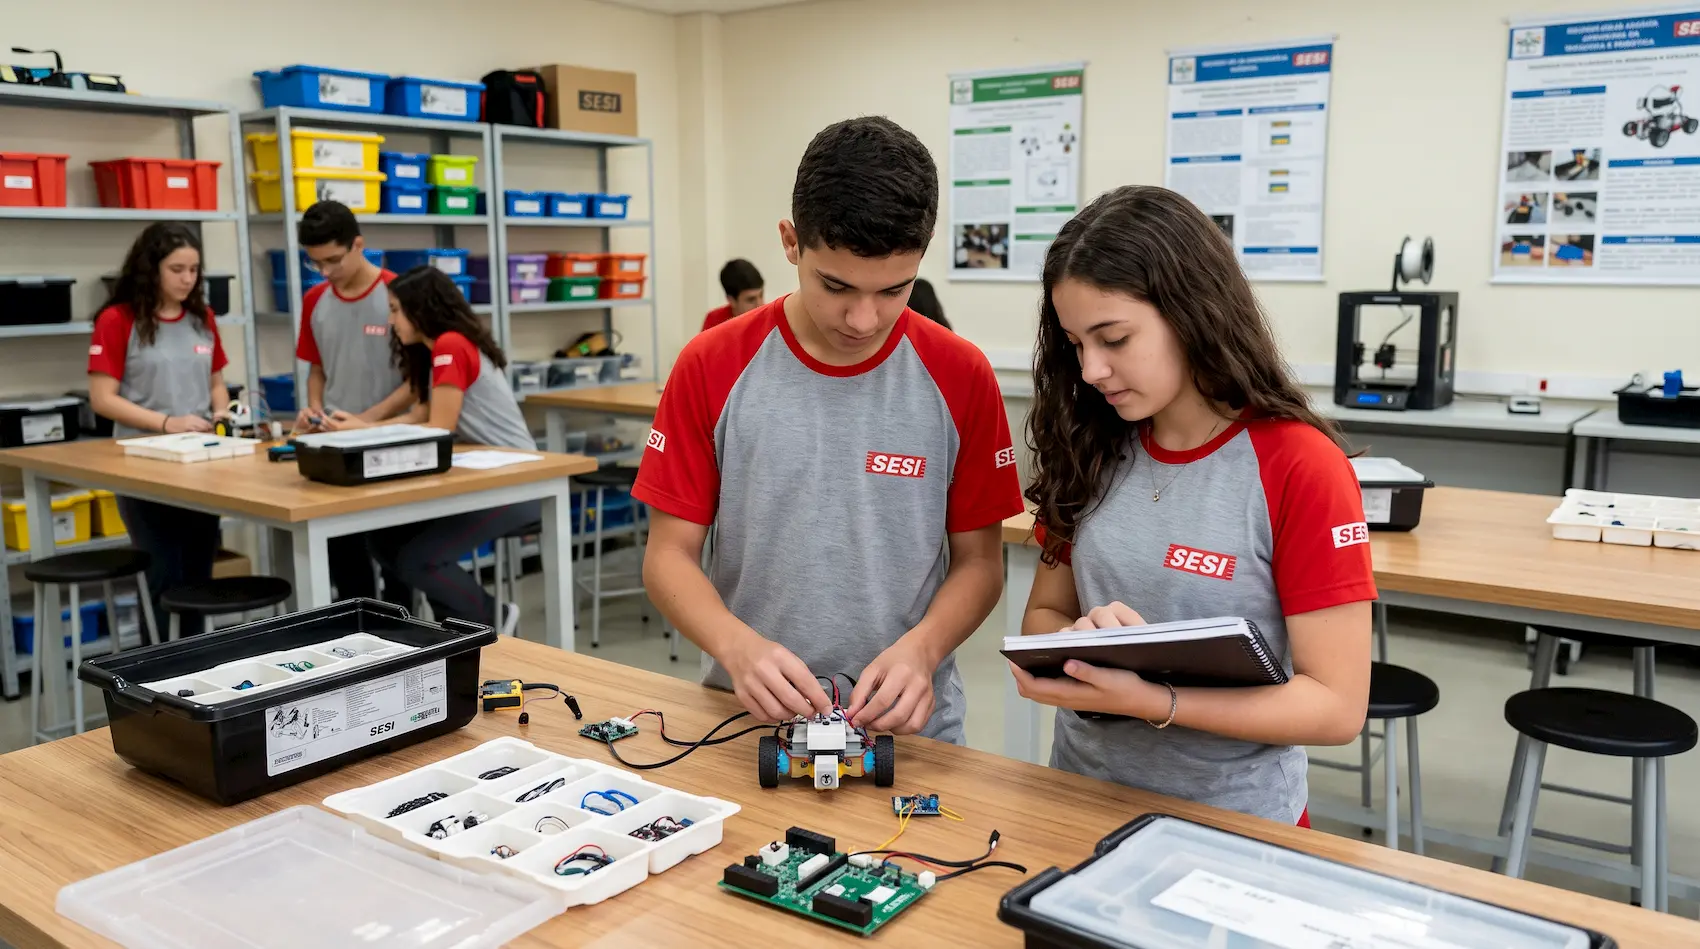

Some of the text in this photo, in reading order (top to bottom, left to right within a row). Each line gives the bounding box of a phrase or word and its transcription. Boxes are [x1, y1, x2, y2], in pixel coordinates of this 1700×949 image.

[583, 93, 617, 111] SESI
[649, 432, 663, 448] SI
[871, 455, 921, 476] SESI
[1169, 548, 1229, 577] SESI
[370, 720, 394, 736] SESI
